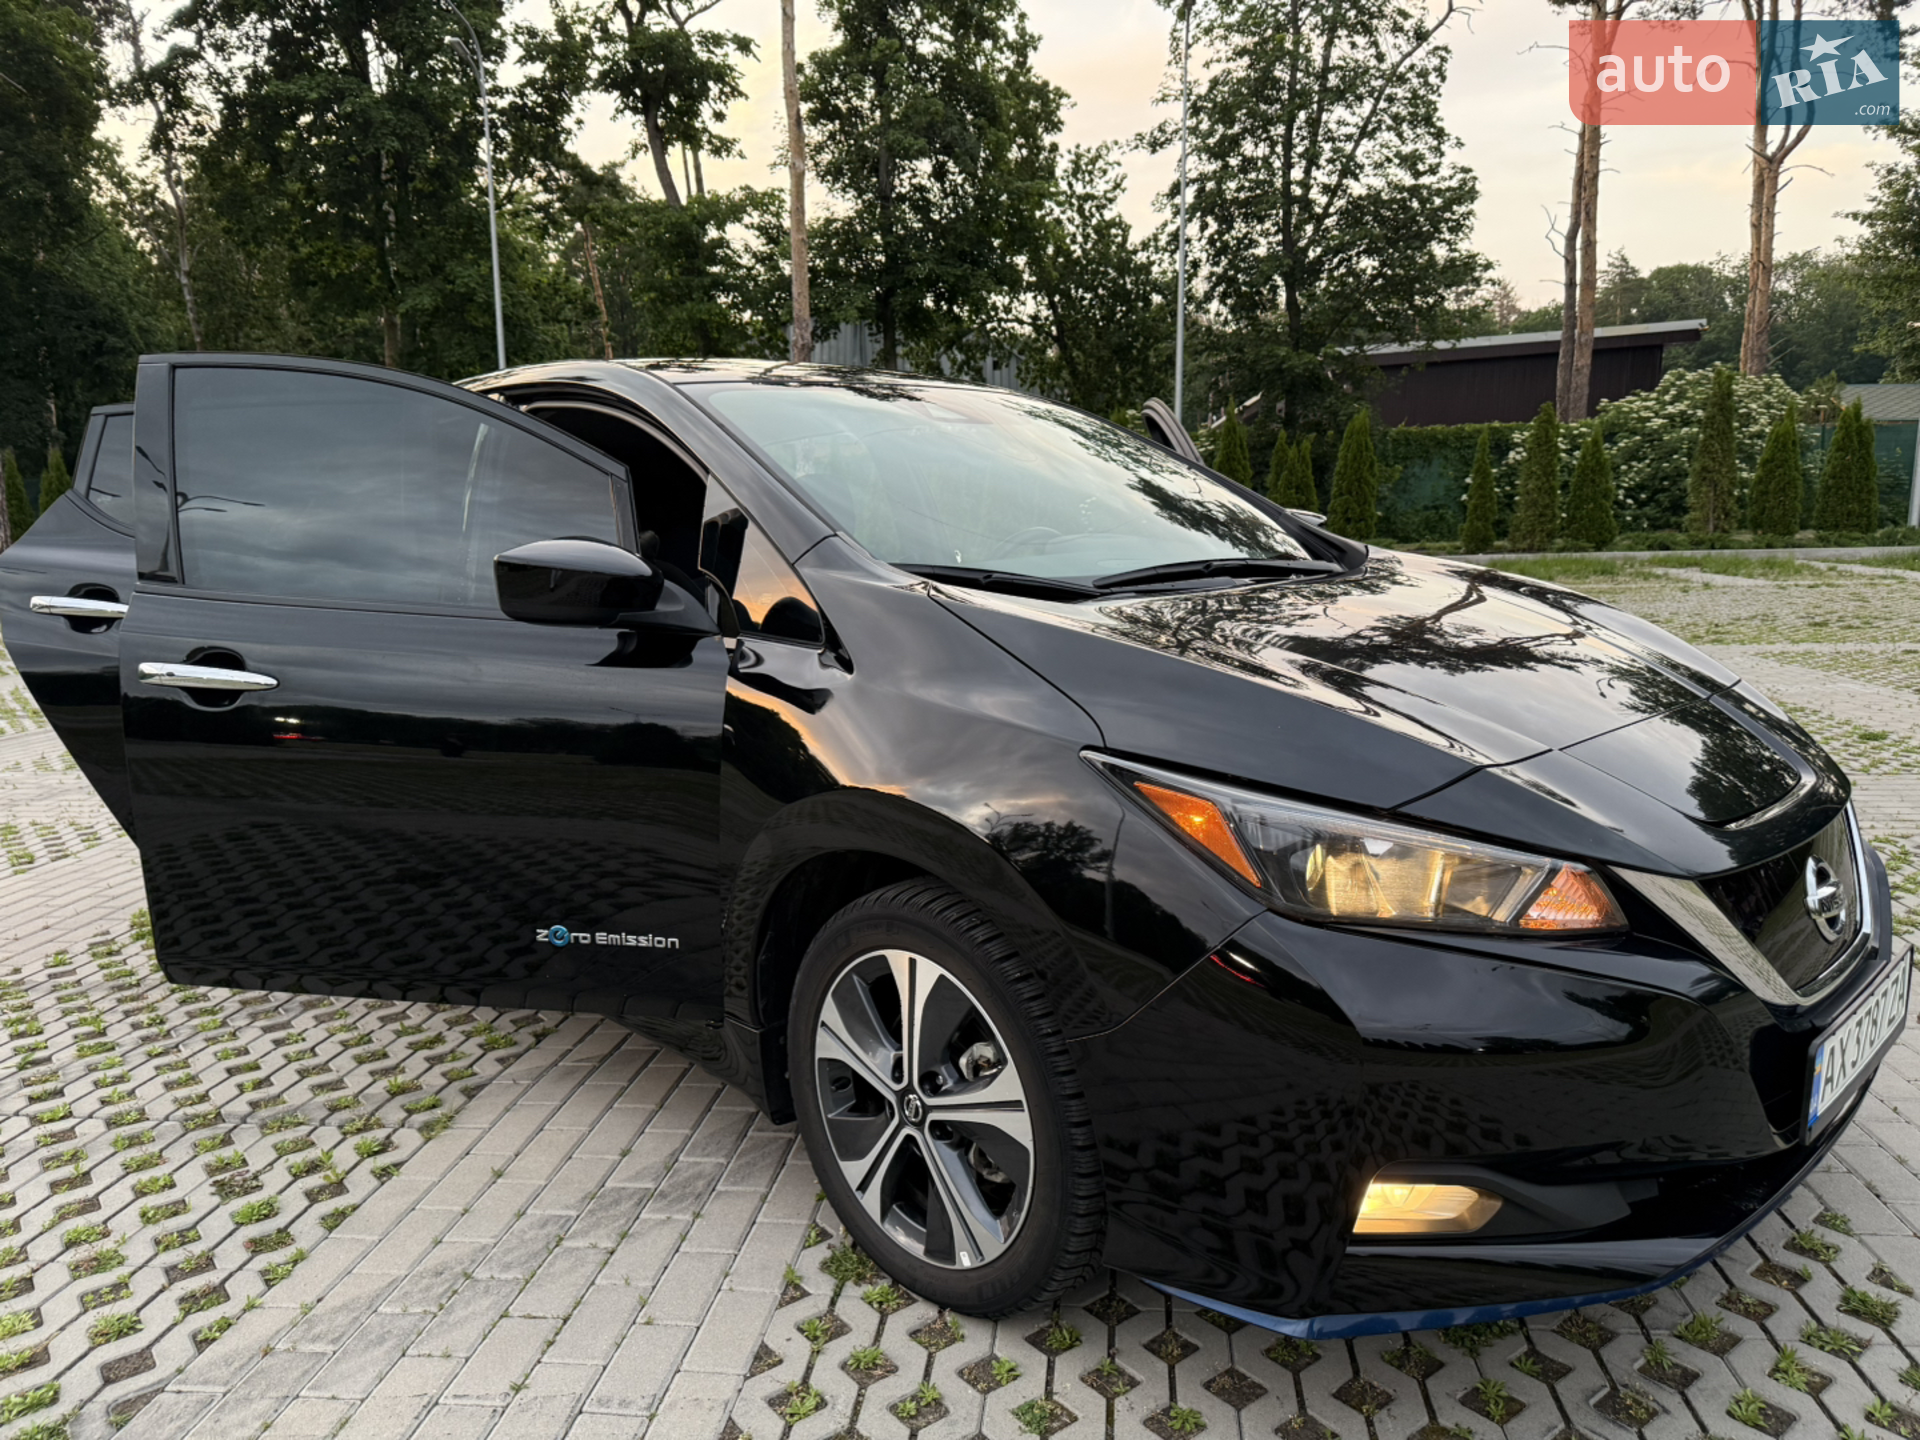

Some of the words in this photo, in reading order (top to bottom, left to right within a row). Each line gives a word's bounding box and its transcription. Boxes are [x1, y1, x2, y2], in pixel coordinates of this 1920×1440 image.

[594, 932, 680, 949] Emission
[1820, 1027, 1851, 1102] AX
[1850, 988, 1888, 1068] 3787
